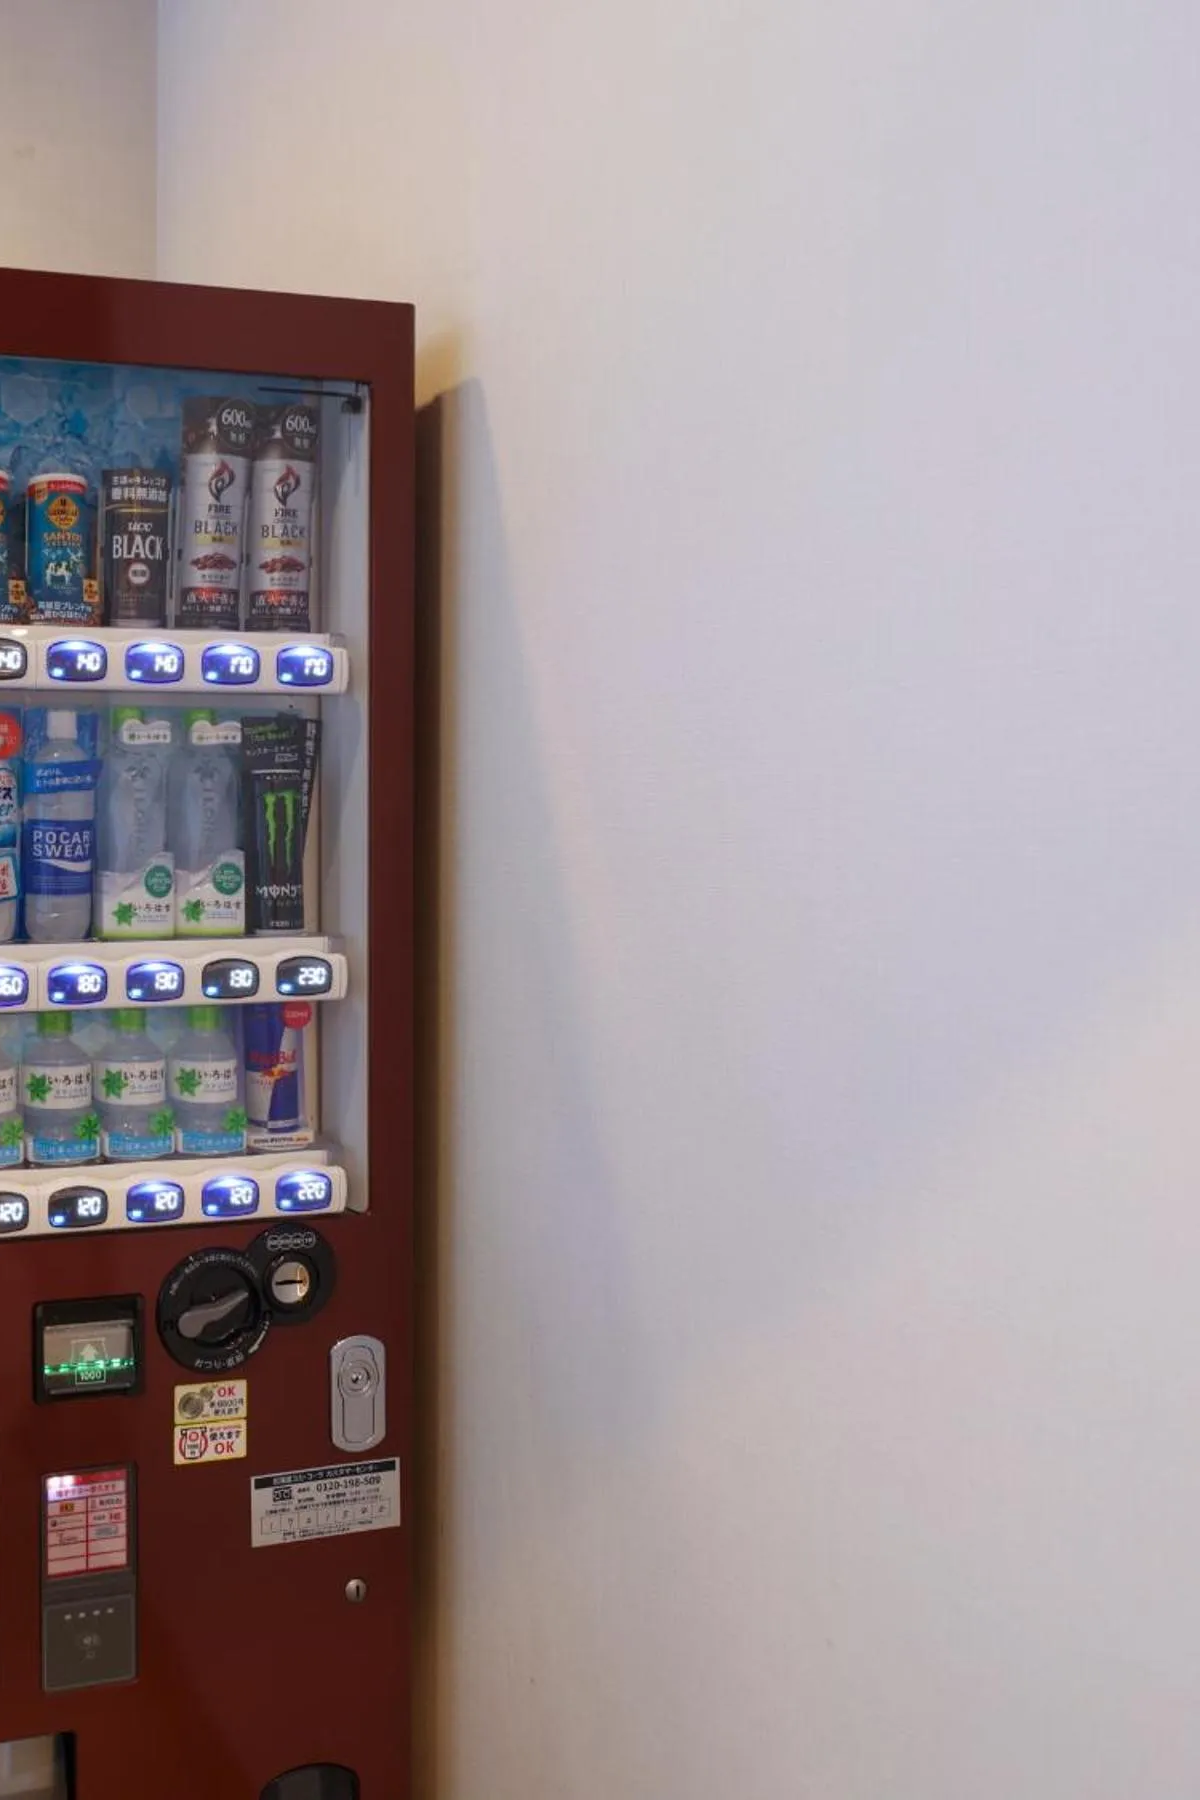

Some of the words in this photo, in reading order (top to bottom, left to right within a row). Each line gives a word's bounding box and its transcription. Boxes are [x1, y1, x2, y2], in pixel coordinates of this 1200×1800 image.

[194, 519, 238, 536] BLACK
[261, 524, 305, 539] BLACK
[111, 535, 164, 561] BLACK
[78, 652, 101, 672] 140
[156, 654, 178, 673] 140
[231, 656, 253, 675] 170
[305, 658, 327, 676] 170
[32, 844, 90, 858] SWEAT
[78, 974, 101, 993] 180
[299, 967, 327, 985] 230
[231, 1186, 253, 1205] 120
[299, 1180, 326, 1199] 220
[78, 1197, 101, 1216] 120
[156, 1191, 178, 1210] 120
[0, 1203, 24, 1222] 120
[79, 1371, 103, 1381] 1000
[217, 1385, 236, 1398] OK
[214, 1440, 235, 1454] OK
